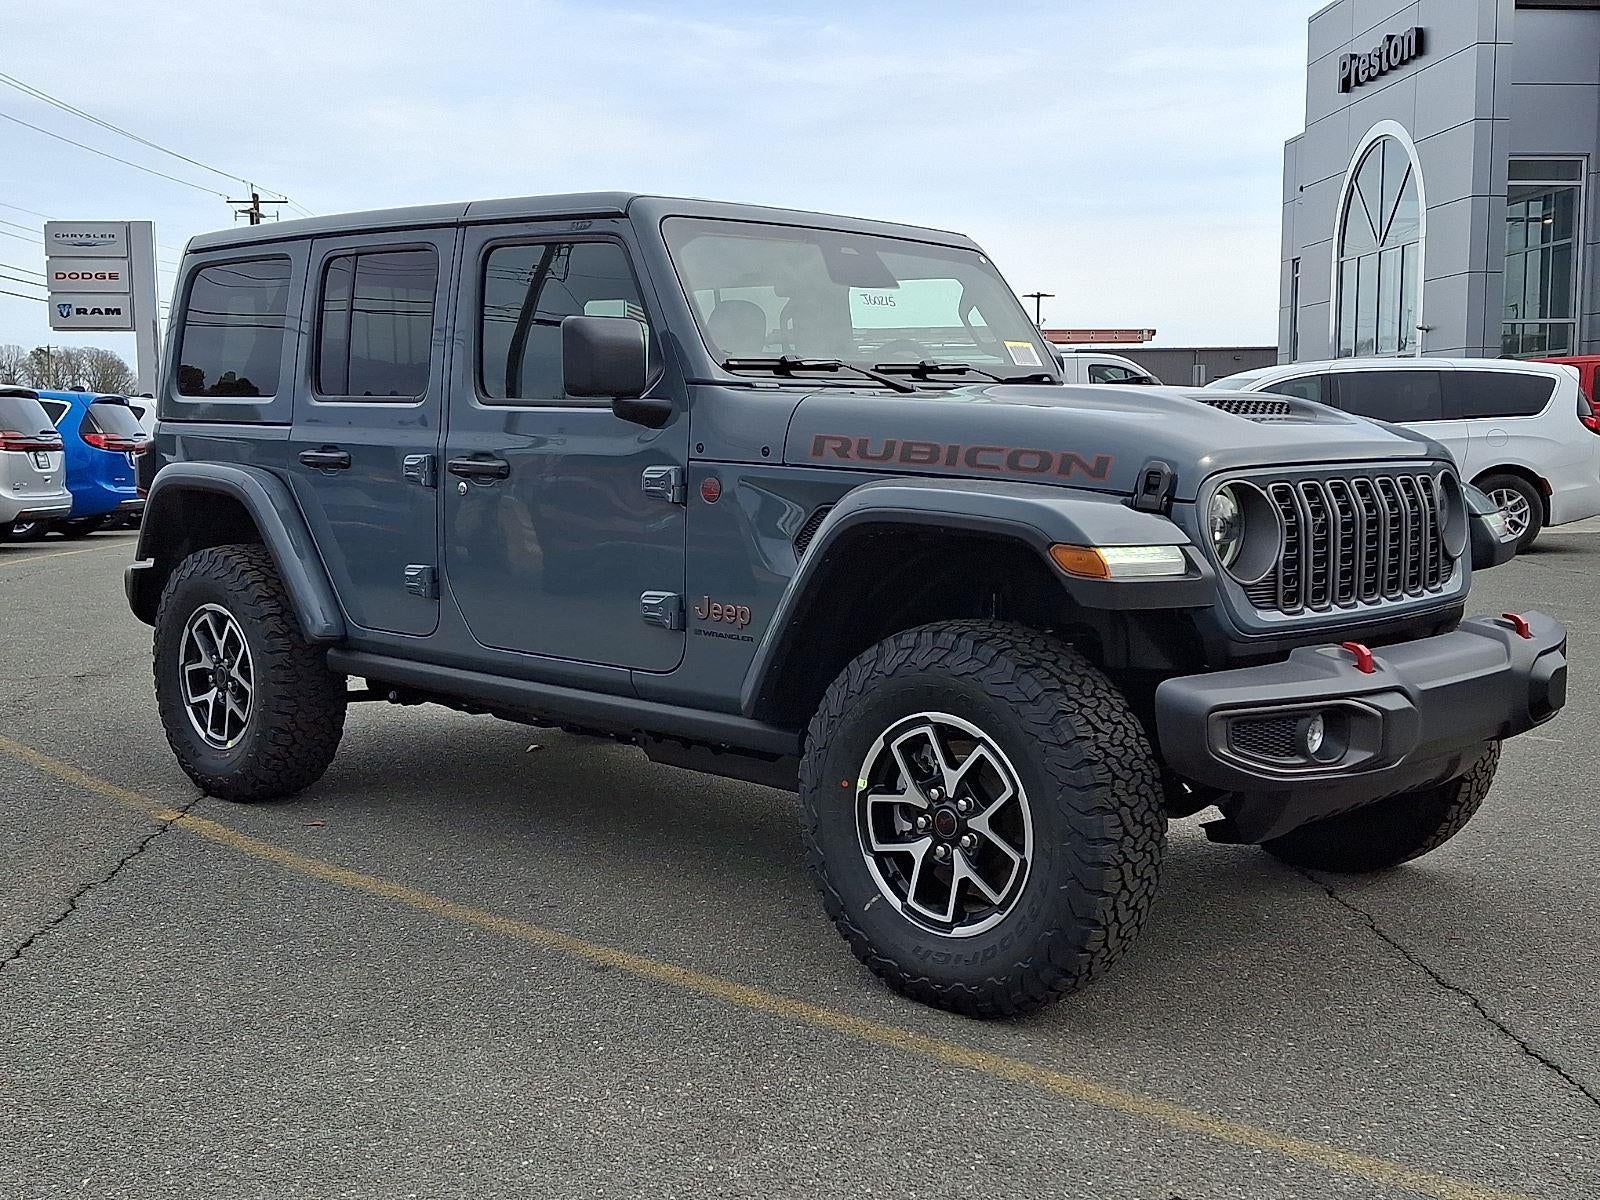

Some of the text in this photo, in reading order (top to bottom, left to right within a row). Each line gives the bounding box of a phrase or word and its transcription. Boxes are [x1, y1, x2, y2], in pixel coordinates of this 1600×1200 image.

[1338, 26, 1424, 93] Preston
[54, 272, 120, 281] DODGE
[75, 307, 122, 316] RAM
[811, 433, 1114, 481] RUBICON
[694, 595, 752, 630] Jeep
[702, 629, 754, 643] WRANGLER
